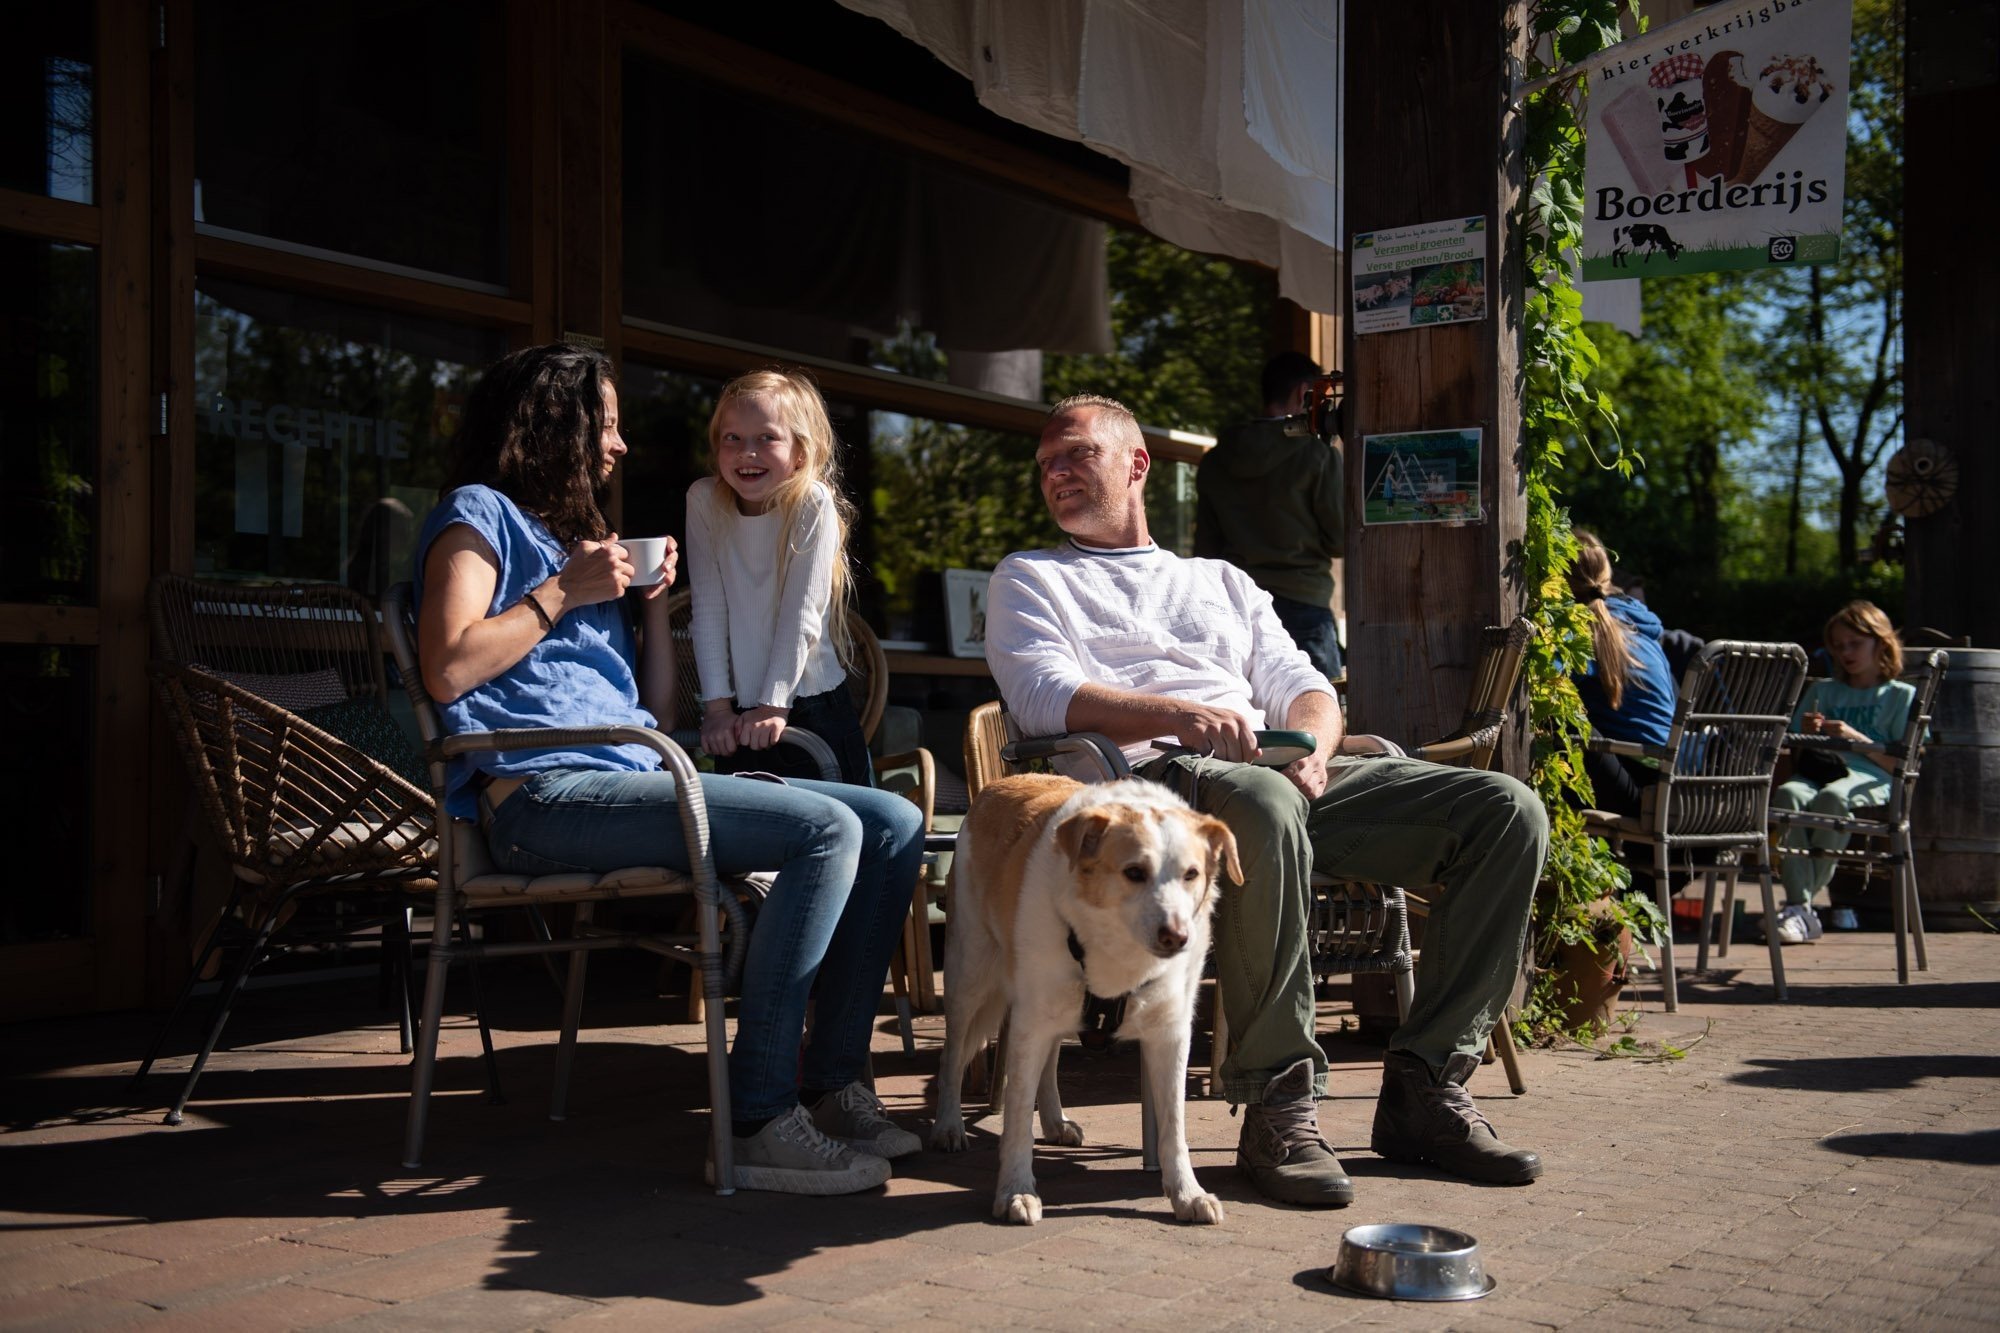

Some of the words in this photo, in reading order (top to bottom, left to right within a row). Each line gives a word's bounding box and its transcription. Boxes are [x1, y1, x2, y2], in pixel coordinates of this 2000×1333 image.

[1602, 53, 1652, 81] hier
[1664, 0, 1811, 56] verkrijgba
[1594, 170, 1828, 222] Boerderijs
[1366, 261, 1393, 272] Verse
[1395, 248, 1474, 271] groenten/Brood
[1374, 241, 1419, 256] Verzamel
[1420, 235, 1466, 252] groenten
[1771, 244, 1794, 255] EKO
[208, 397, 409, 460] RECEPTIE
